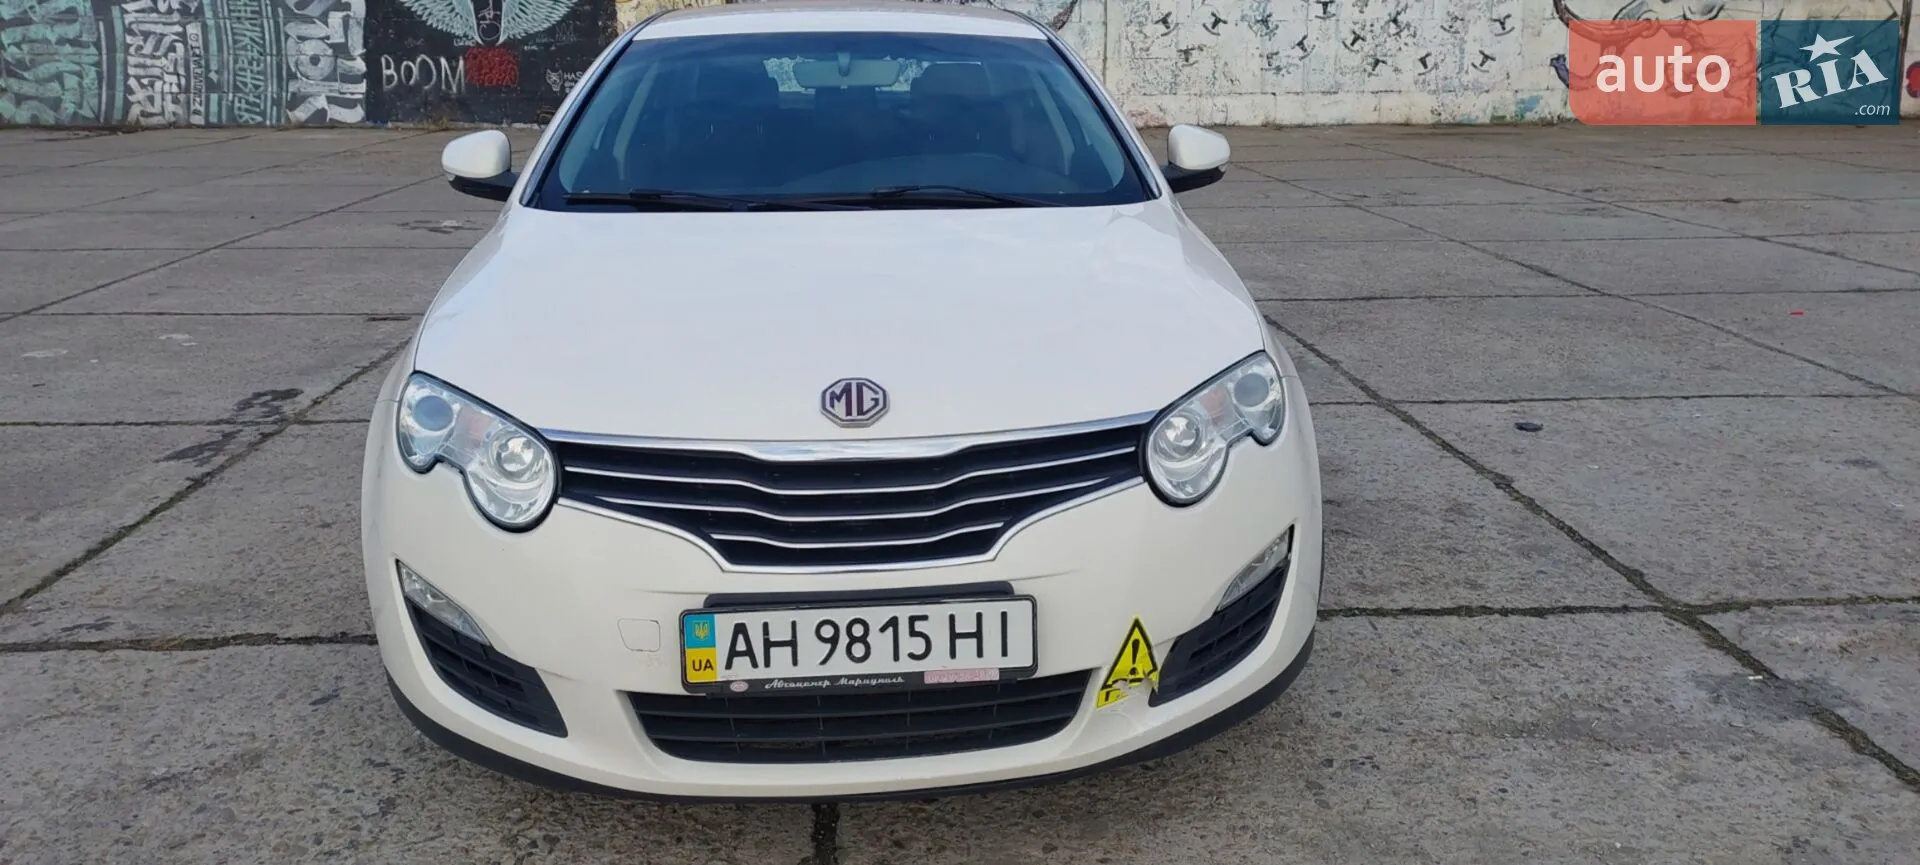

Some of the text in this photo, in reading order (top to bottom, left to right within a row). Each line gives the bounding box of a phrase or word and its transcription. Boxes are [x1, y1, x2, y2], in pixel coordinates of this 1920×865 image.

[829, 381, 879, 417] MG
[724, 610, 1009, 671] AH 9815 HI
[692, 658, 714, 672] UA
